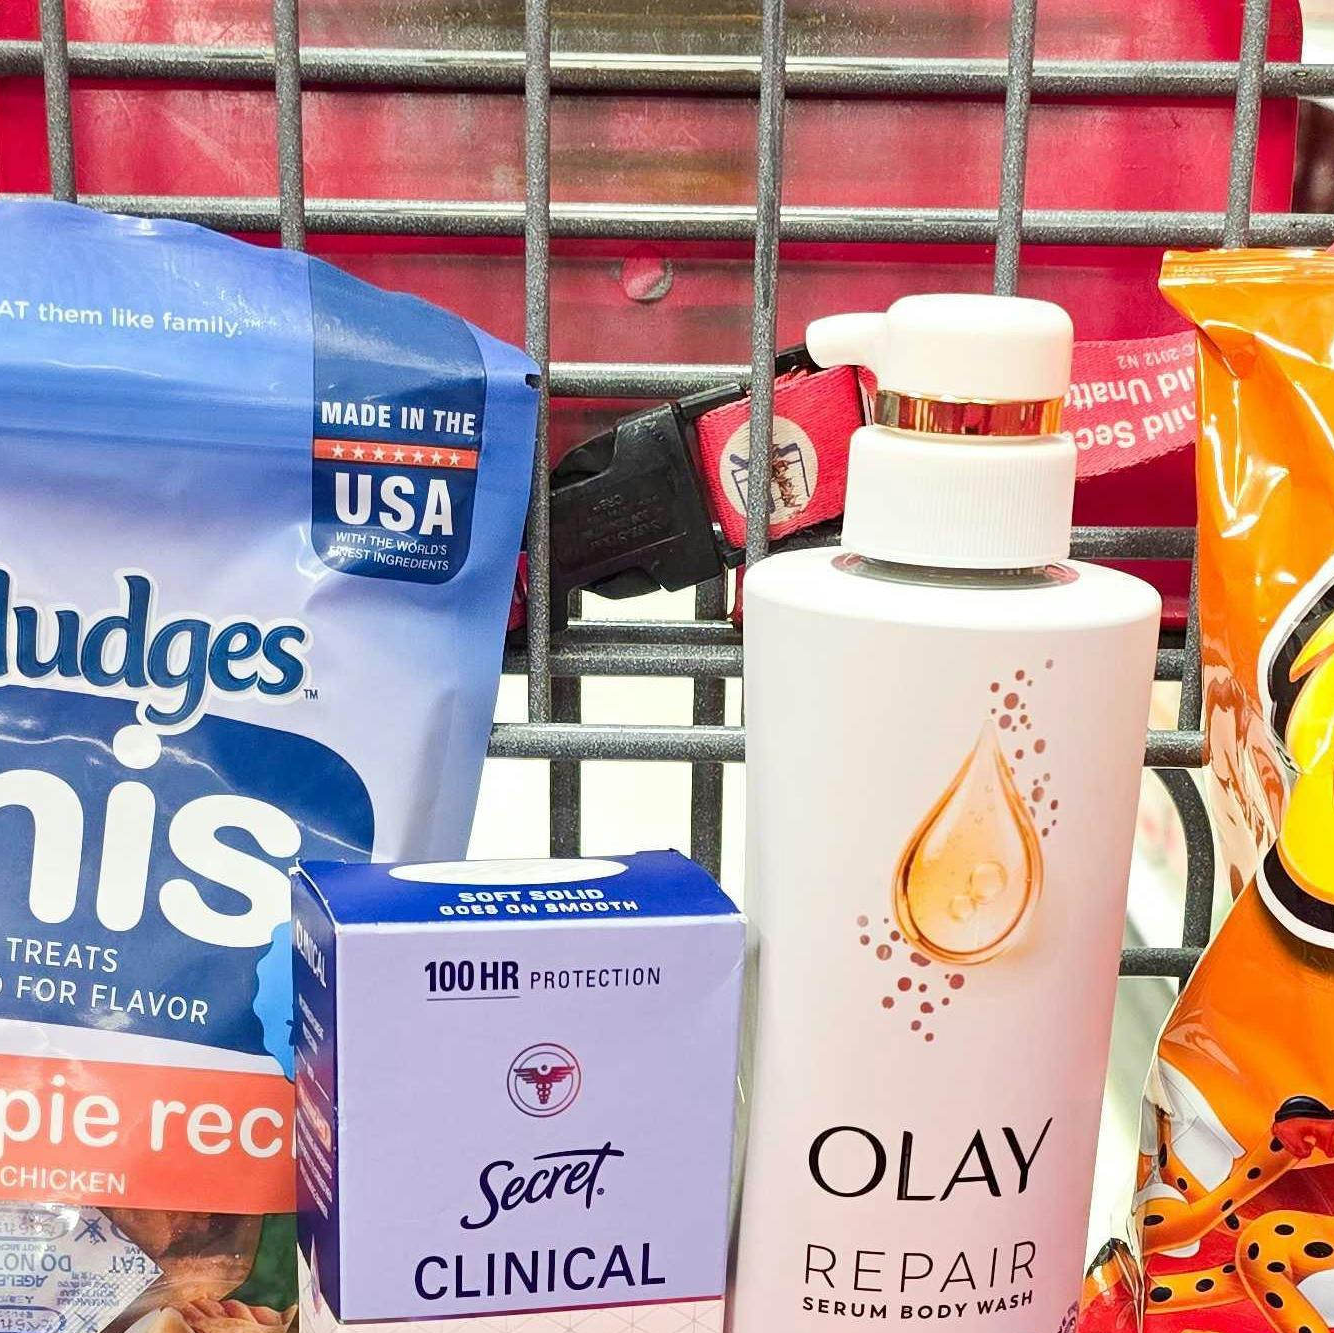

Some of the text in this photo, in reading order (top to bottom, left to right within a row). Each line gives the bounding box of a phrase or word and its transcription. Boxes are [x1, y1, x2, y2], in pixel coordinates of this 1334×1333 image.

[38, 301, 104, 327] them
[111, 307, 155, 331] like
[1144, 348, 1180, 367] 2012
[321, 401, 476, 436] MADE IN THE
[335, 471, 454, 536] USA
[336, 531, 447, 556] WITH THE WORLD'S
[373, 552, 449, 571] INGREDIENTS
[439, 900, 638, 916] GOES ON SMOOTH
[458, 888, 604, 903] SOFT SOLID
[6, 936, 119, 973] TREATS
[424, 960, 662, 992] 100 HR PROTECTION
[15, 972, 77, 1005] FOR
[89, 982, 210, 1026] FLAVOR
[807, 1117, 1052, 1201] OLAY
[41, 1255, 71, 1272] DO
[414, 1242, 666, 1301] CLINICAL
[804, 1240, 1037, 1293] REPAIR
[803, 1290, 1033, 1320] SERUM BODY WASH
